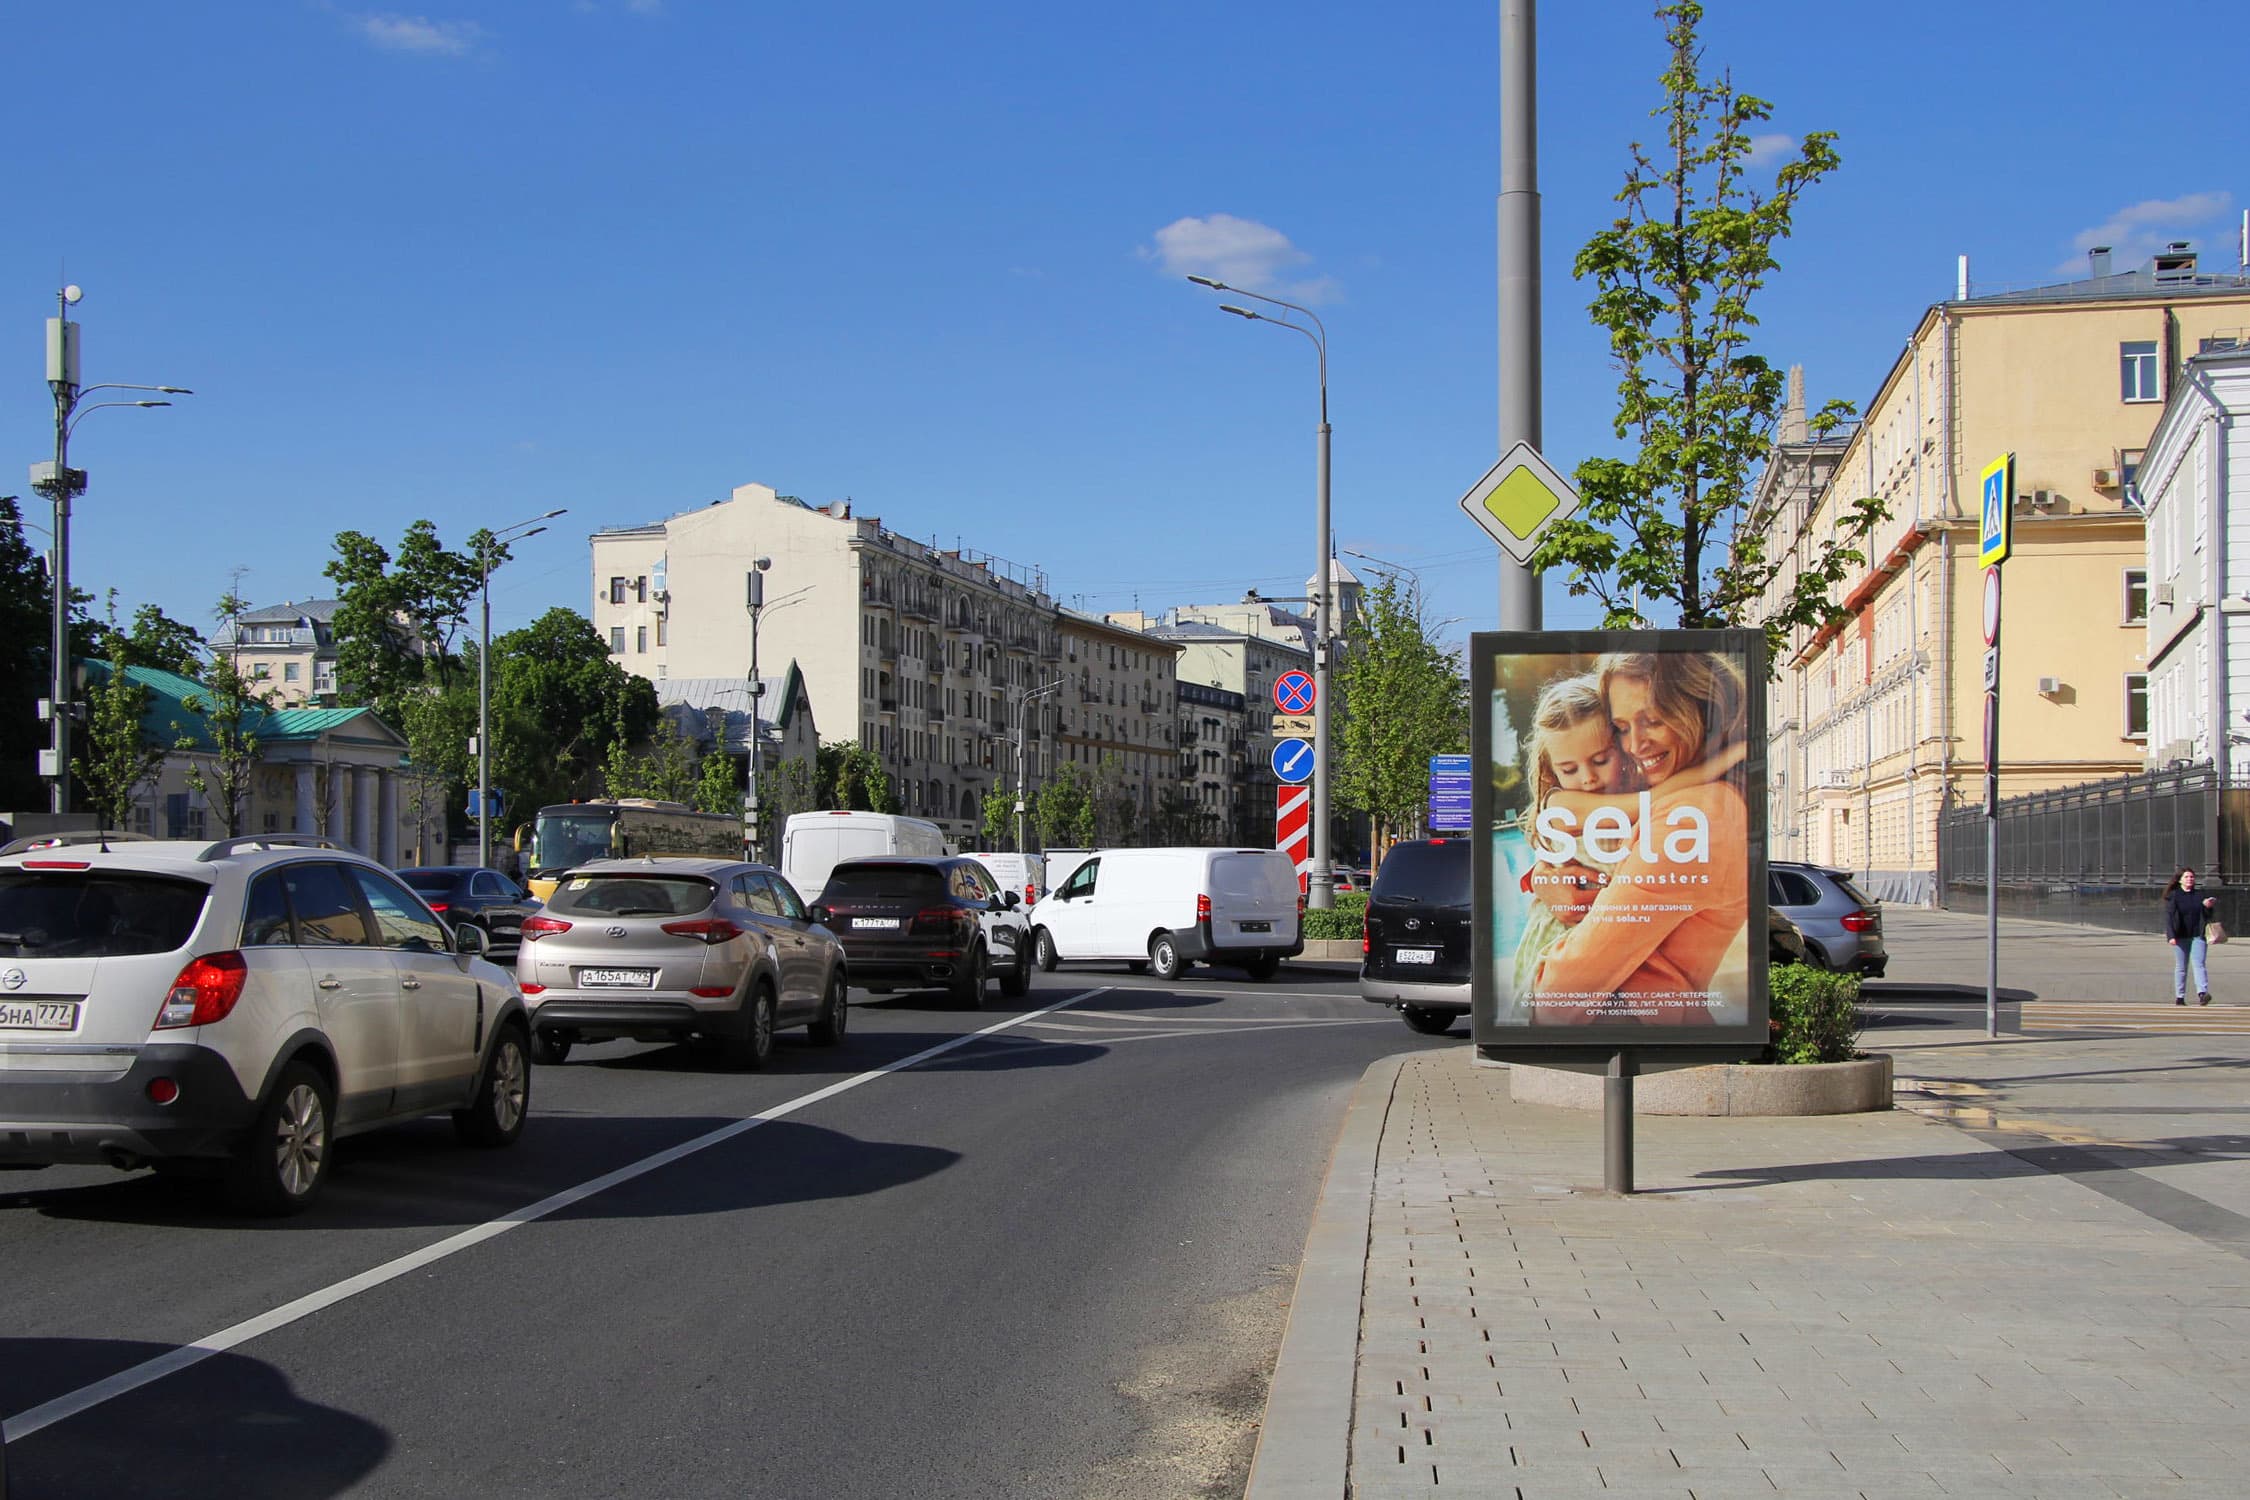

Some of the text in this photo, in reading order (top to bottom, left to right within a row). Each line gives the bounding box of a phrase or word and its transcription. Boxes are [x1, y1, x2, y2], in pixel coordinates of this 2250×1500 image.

[1535, 791, 1709, 865] sela
[1534, 872, 1709, 885] moms & monsters
[1551, 903, 1586, 912] летние
[1641, 903, 1693, 912] магазинах
[40, 1004, 68, 1019] 777
